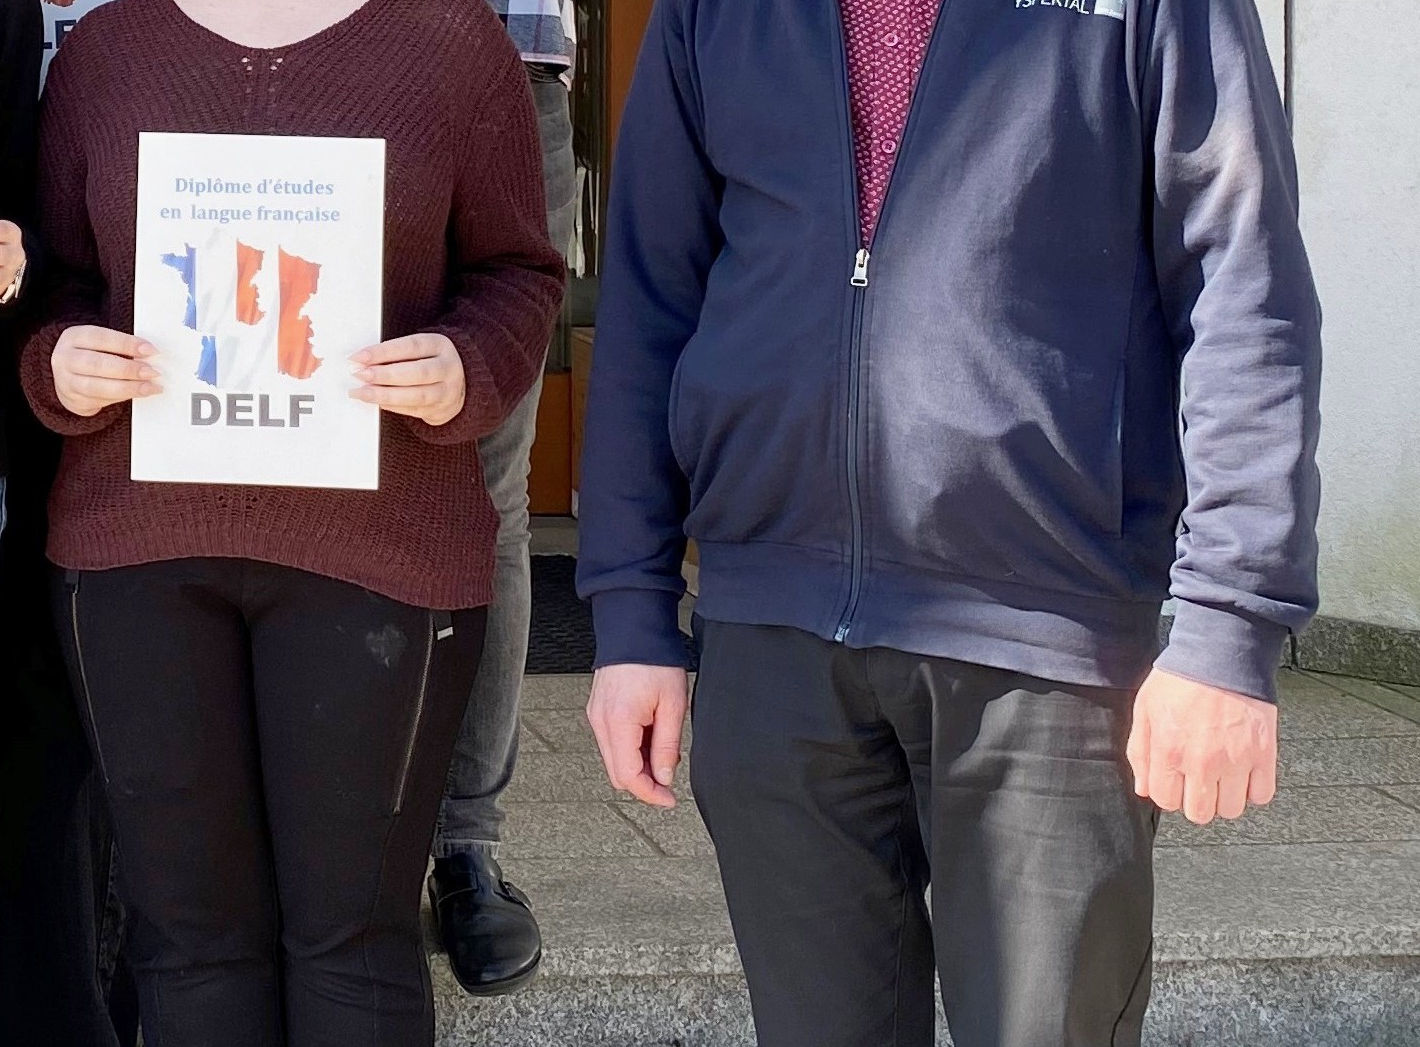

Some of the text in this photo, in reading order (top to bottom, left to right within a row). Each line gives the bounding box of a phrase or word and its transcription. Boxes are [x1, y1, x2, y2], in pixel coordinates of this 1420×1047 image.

[175, 177, 252, 198] Diplôme
[160, 203, 341, 224] en langue française
[190, 392, 316, 428] DELF
